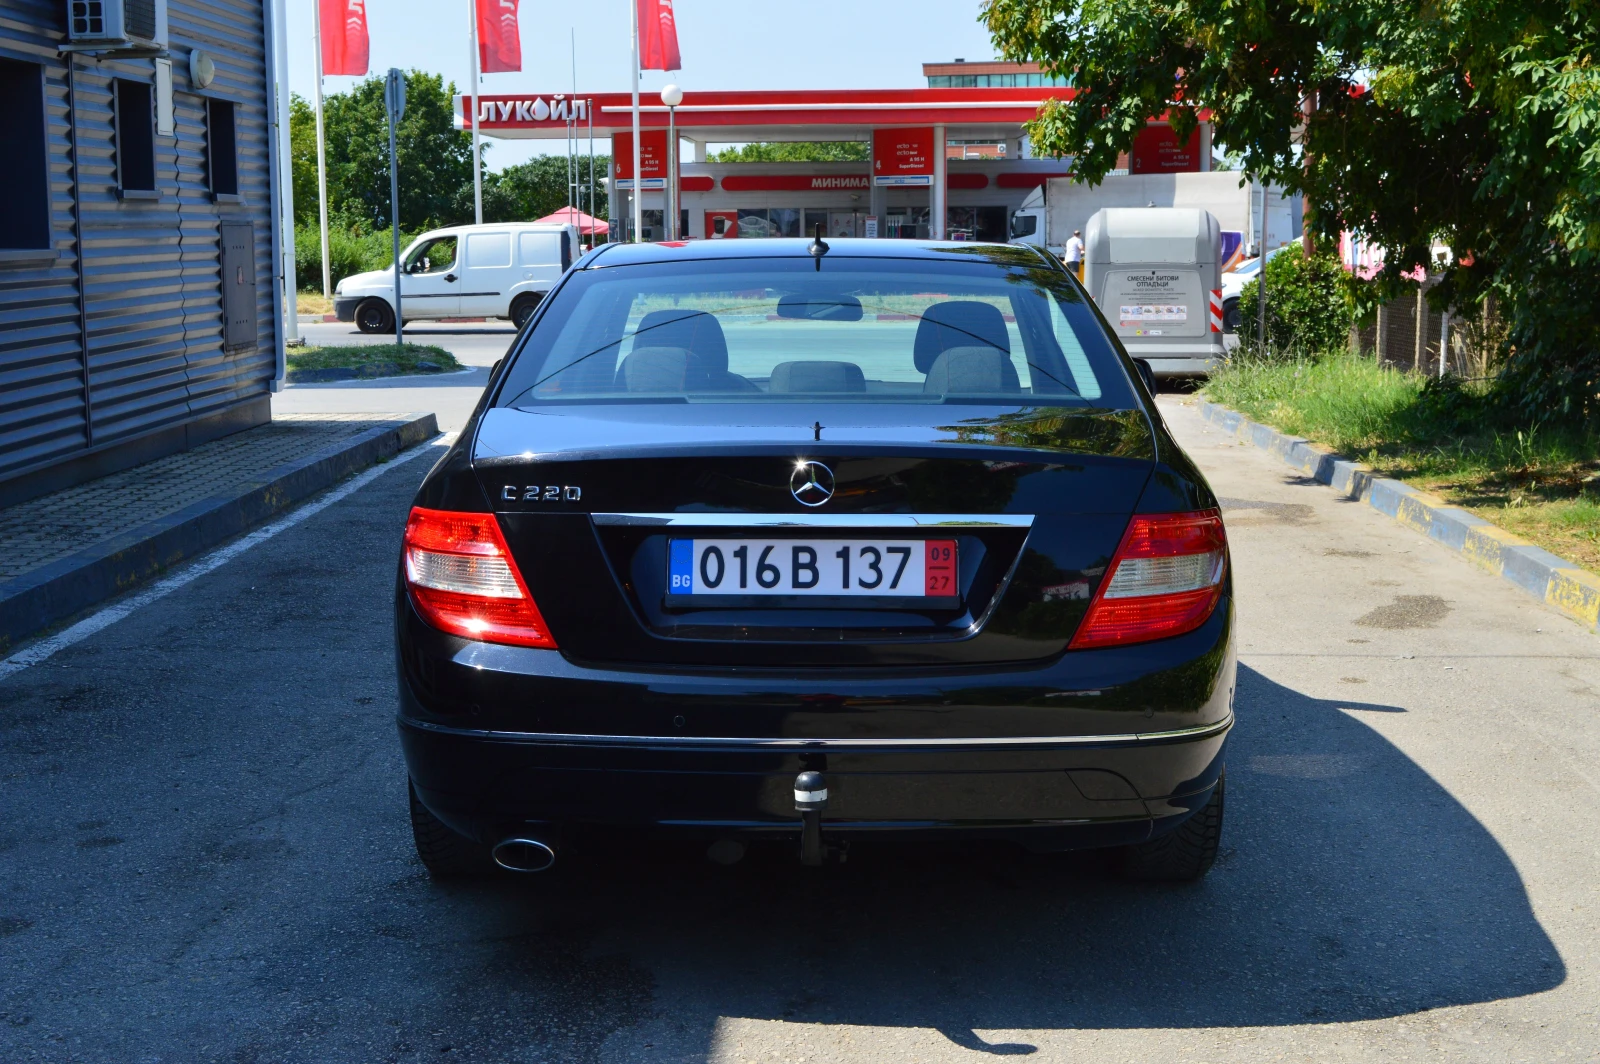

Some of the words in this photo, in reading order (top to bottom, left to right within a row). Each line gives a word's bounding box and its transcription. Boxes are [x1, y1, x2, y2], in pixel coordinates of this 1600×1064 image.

[478, 94, 586, 122] ЛУКОЙЛ
[616, 163, 621, 173] 6
[876, 160, 881, 170] 4
[1136, 158, 1141, 168] 2
[811, 178, 870, 188] МИНИМА
[501, 485, 517, 501] C
[522, 485, 581, 501] 220
[931, 547, 950, 561] 09
[672, 574, 691, 588] BG
[929, 575, 950, 590] 27
